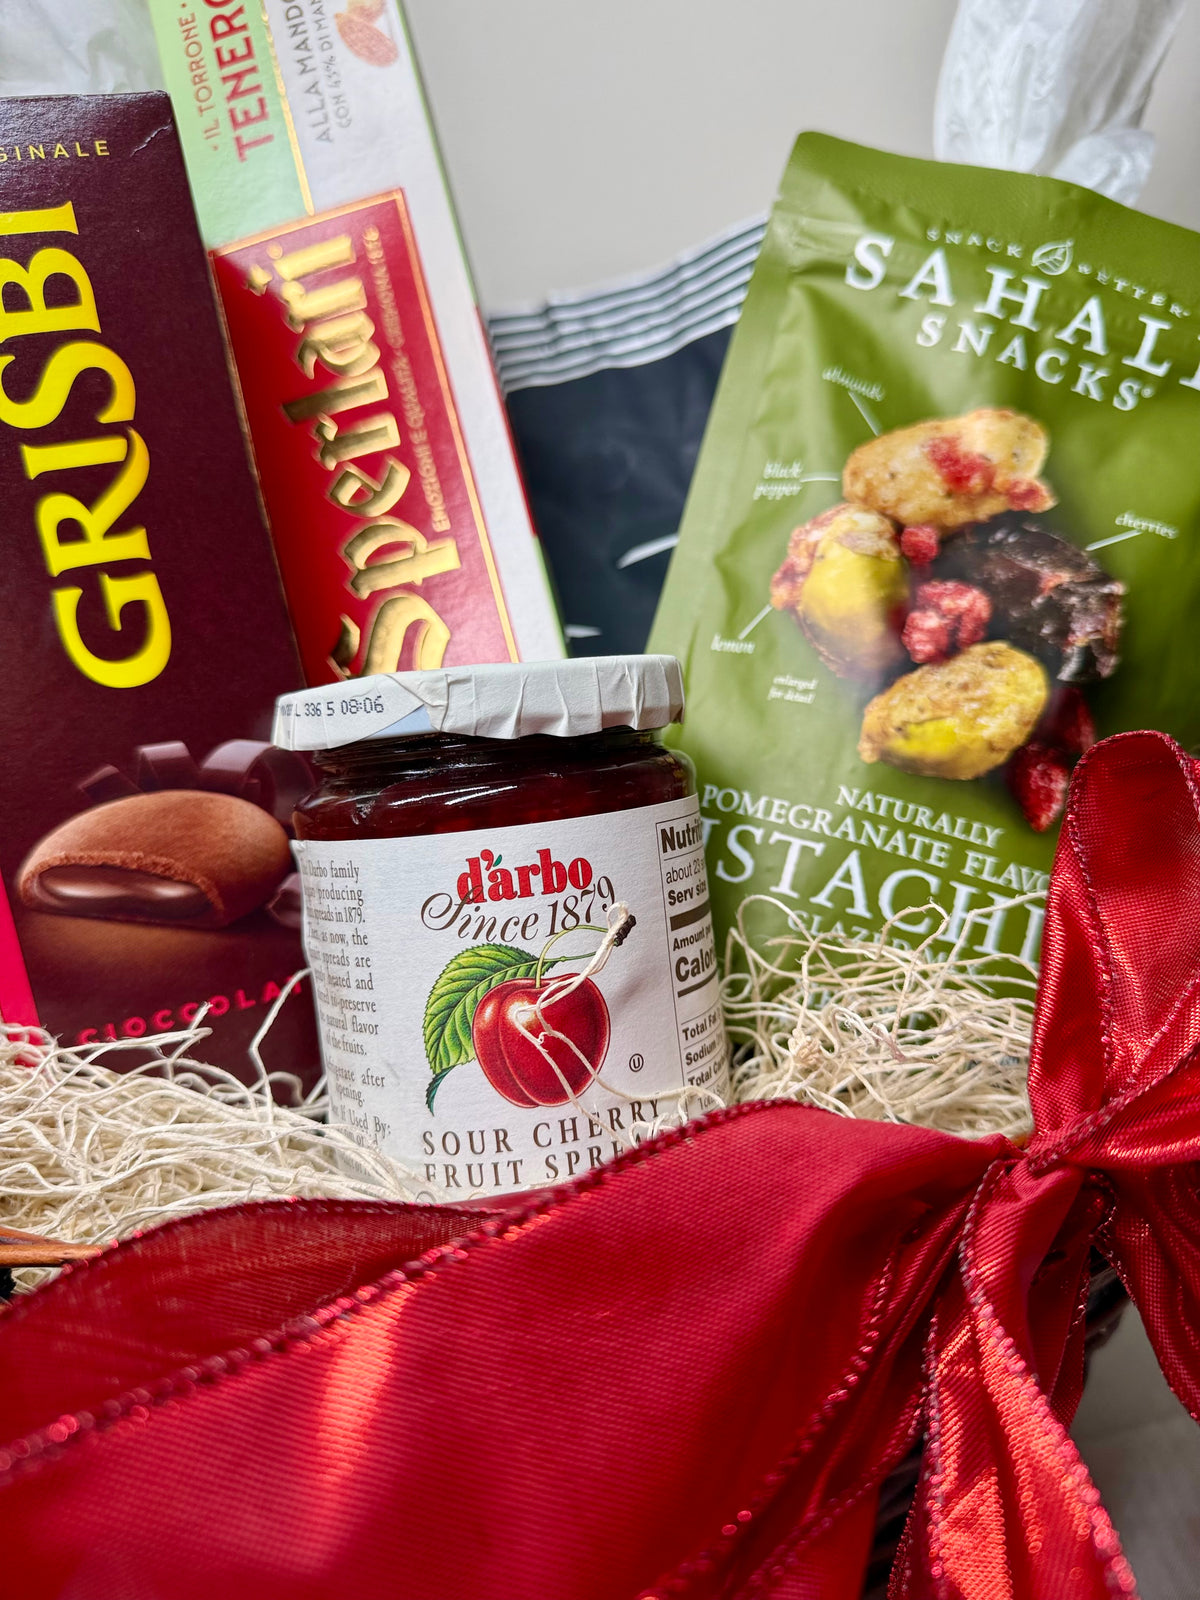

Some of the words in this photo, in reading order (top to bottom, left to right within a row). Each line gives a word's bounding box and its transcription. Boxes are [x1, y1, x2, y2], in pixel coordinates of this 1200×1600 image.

[283, 0, 317, 75] MAND
[178, 12, 215, 117] TORRONE
[304, 81, 333, 142] ALLA
[926, 228, 1023, 258] SNACK
[0, 200, 172, 689] GRISBI
[304, 702, 322, 717] 336
[326, 701, 335, 716] 5
[340, 696, 384, 715] 08:06
[702, 783, 951, 868] POMEGRANATE
[837, 785, 1004, 849] NATURALLY
[660, 817, 703, 853] Nutri
[330, 860, 360, 884] family
[666, 861, 693, 884] about
[318, 882, 364, 907] producing
[667, 884, 695, 906] Serv
[335, 906, 344, 922] in
[344, 906, 366, 924] 1879.
[420, 885, 540, 942] Since
[545, 875, 616, 938] 1879
[329, 932, 349, 947] now,
[352, 927, 369, 946] the
[672, 926, 705, 952] Amount
[354, 956, 371, 968] are
[675, 945, 717, 982] Calor
[355, 972, 374, 990] and
[339, 997, 377, 1014] preserve
[352, 1015, 379, 1035] flavor
[682, 1017, 708, 1041] Total
[341, 1034, 367, 1056] fruits.
[685, 1039, 718, 1066] Sodium
[361, 1067, 386, 1088] after
[687, 1065, 713, 1087] Total
[347, 1108, 369, 1130] Used
[373, 1115, 391, 1139] By:
[422, 1128, 514, 1156] SOUR
[532, 1097, 661, 1149] CHERRY
[424, 1158, 524, 1189] FRUIT
